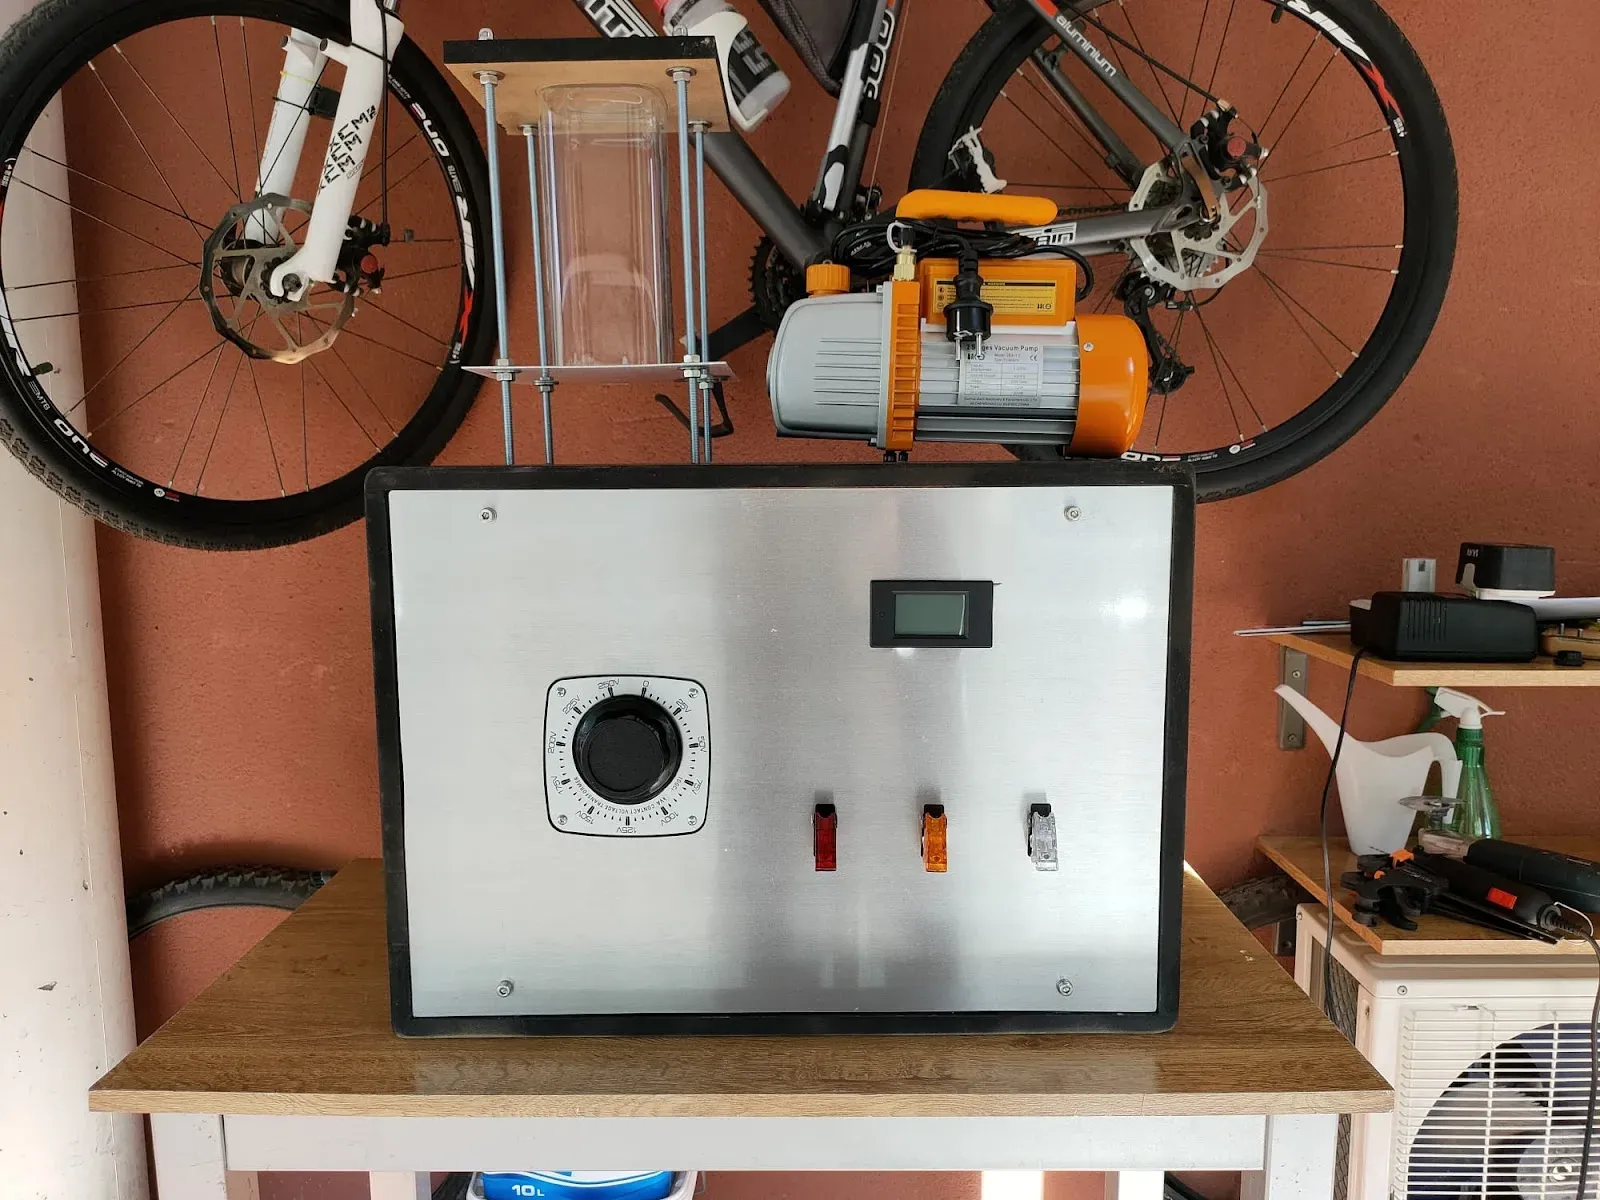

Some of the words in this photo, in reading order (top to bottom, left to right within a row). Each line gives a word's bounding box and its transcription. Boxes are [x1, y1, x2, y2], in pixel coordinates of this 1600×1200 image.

[1056, 15, 1117, 77] aluminium
[971, 344, 993, 352] Sges
[597, 678, 620, 690] 250V
[643, 680, 650, 688] 0
[547, 731, 557, 754] 200V
[630, 803, 655, 815] CONTACT
[616, 826, 637, 834] 125V
